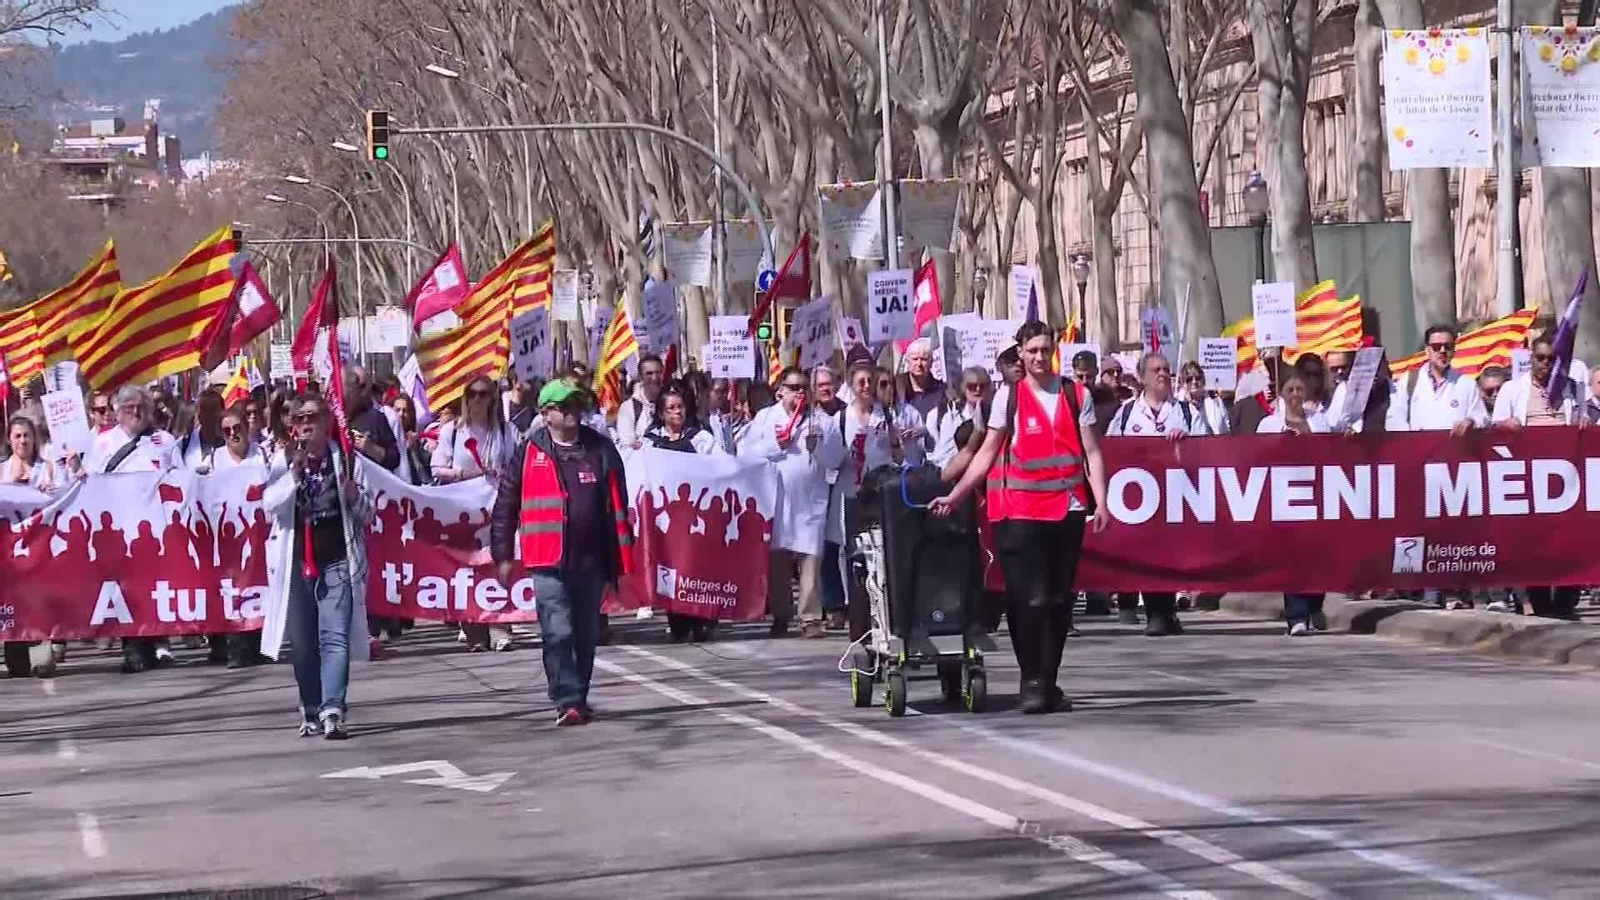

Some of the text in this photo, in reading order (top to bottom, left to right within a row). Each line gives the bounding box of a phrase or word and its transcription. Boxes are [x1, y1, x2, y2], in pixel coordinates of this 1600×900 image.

[875, 294, 908, 314] JA!
[519, 329, 545, 356] JA!
[712, 329, 723, 337] La
[1107, 445, 1600, 524] ONVENI MÈDI
[1427, 541, 1496, 560] Metges de
[1426, 559, 1496, 573] Catalunya
[678, 575, 738, 594] Metges de
[90, 580, 134, 626] A
[151, 580, 207, 622] tu
[678, 590, 737, 609] Catalunya
